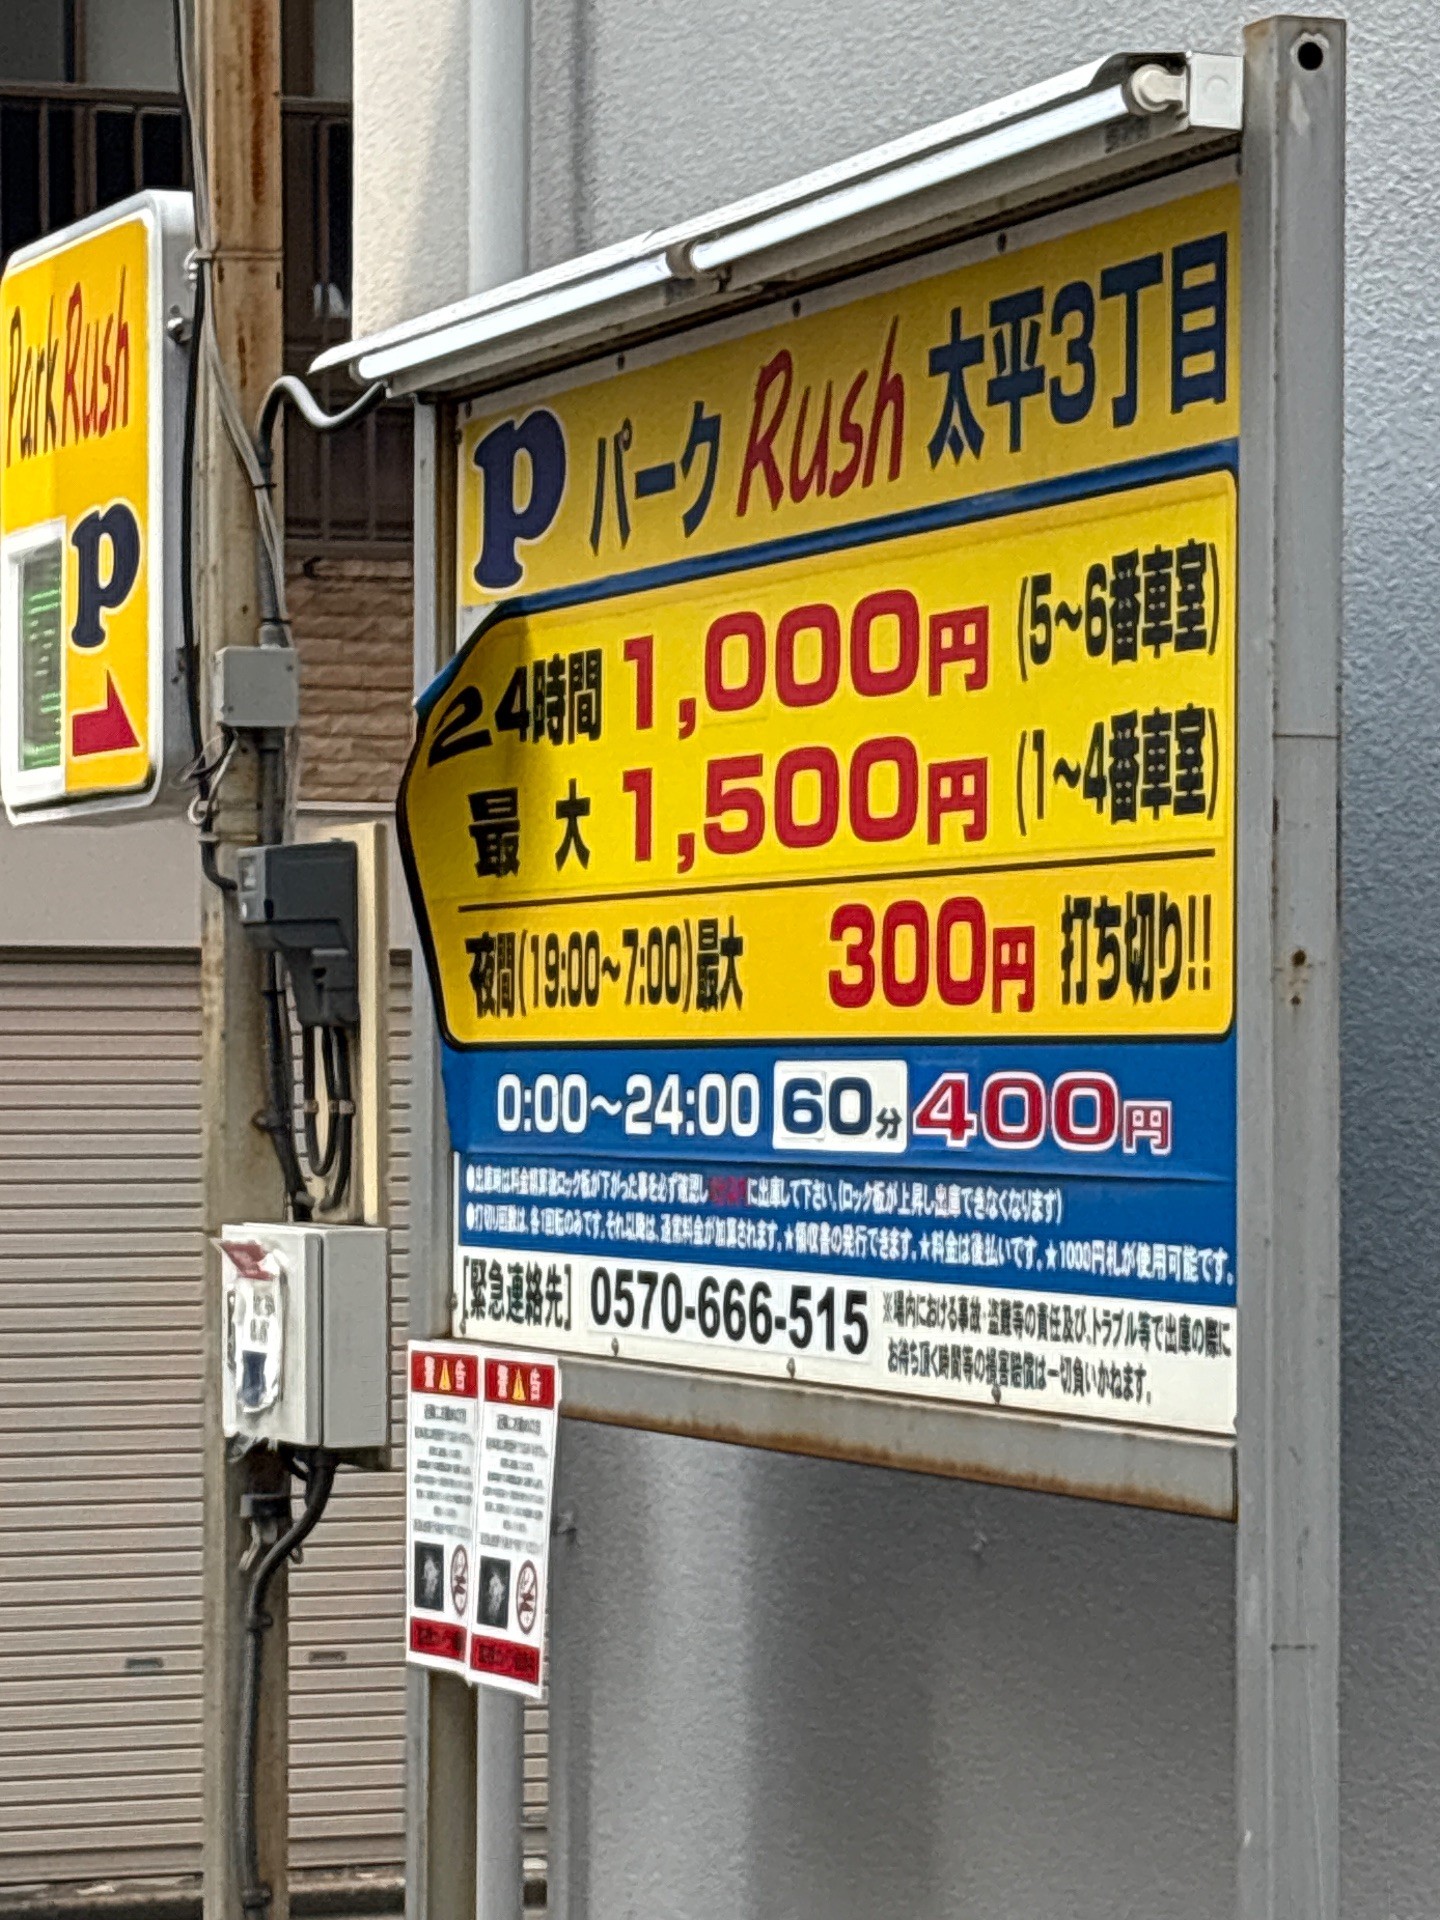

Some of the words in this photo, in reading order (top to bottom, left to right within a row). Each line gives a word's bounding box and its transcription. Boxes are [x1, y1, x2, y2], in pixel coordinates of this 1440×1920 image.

[6, 295, 59, 469] Park
[61, 264, 129, 447] Rush
[589, 401, 721, 556] パーク
[736, 314, 906, 517] Rush
[927, 231, 1228, 471] 太平3丁目
[428, 648, 602, 768] 24時間
[623, 589, 989, 740] 1,000円
[622, 735, 988, 874] 1,500円
[829, 896, 1035, 1013] 300円
[782, 1076, 902, 1139] 60分
[912, 1071, 1173, 1156] 400円
[590, 1266, 869, 1355] 0570-666-515
